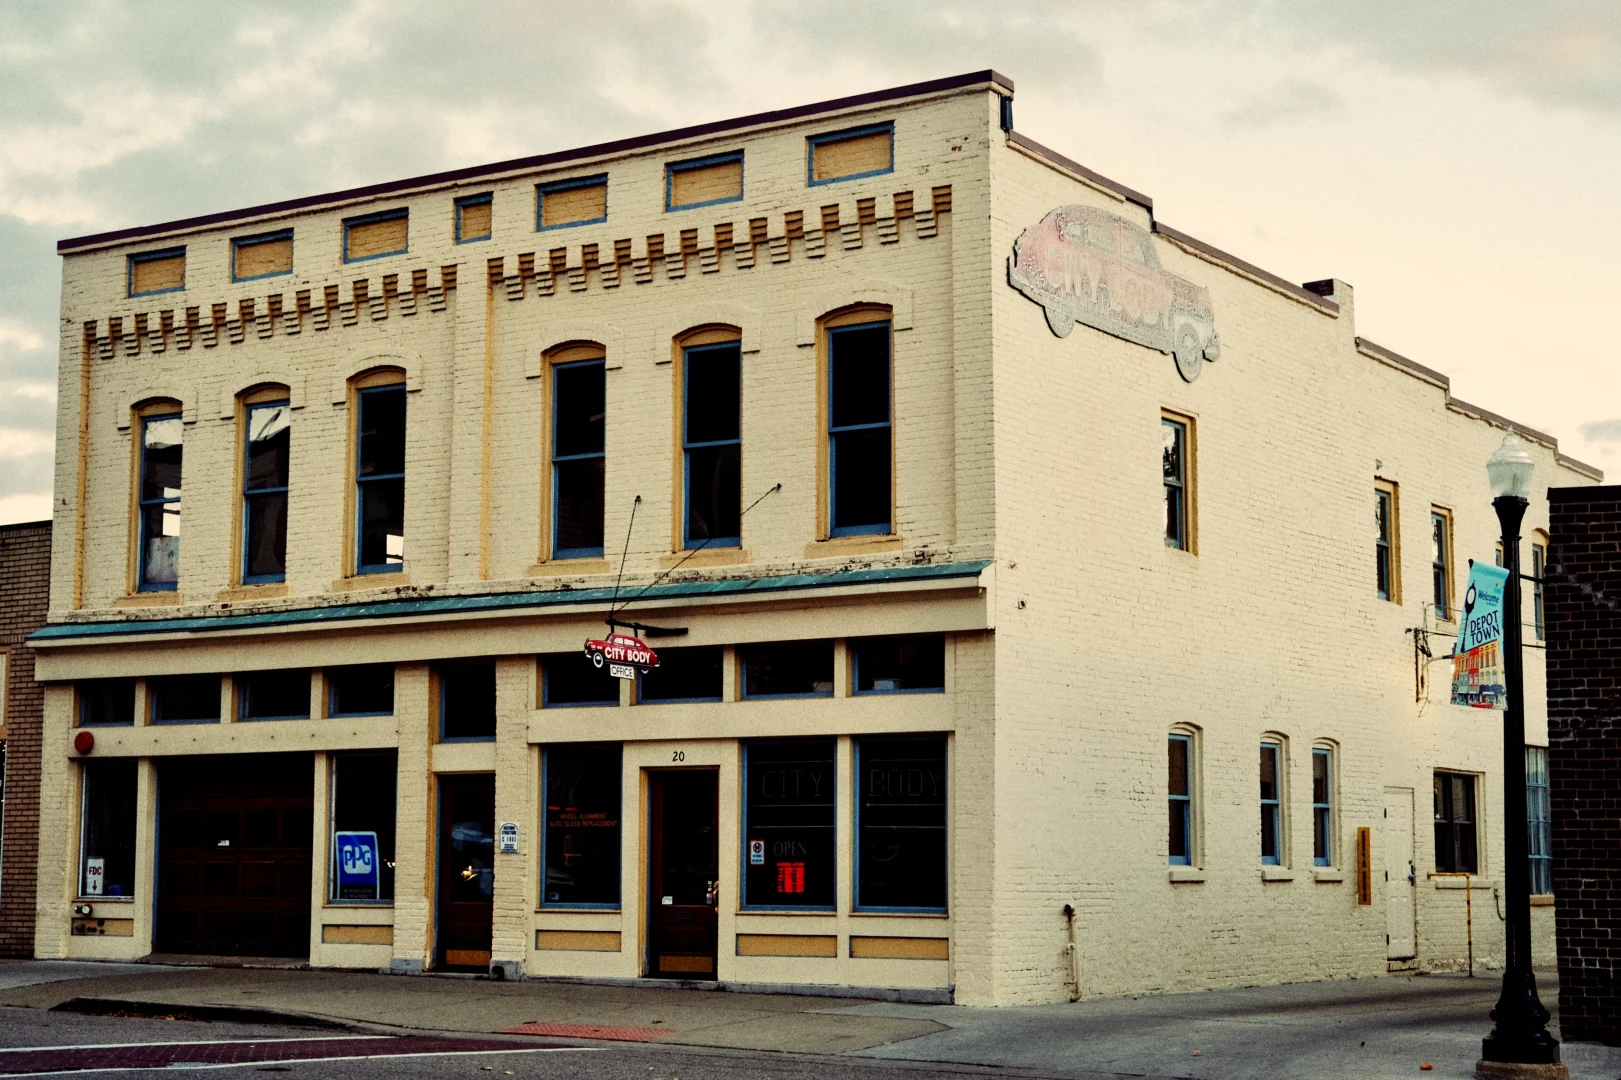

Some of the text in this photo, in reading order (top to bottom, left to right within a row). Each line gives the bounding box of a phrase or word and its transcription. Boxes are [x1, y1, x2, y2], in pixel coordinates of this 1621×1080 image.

[1478, 590, 1499, 604] Welcome
[1470, 610, 1498, 633] DEPOT
[1470, 624, 1500, 646] TOWN
[604, 646, 651, 664] CITY BODY
[611, 666, 633, 678] OFFICE
[672, 751, 685, 762] 20
[762, 769, 823, 798] CITY
[869, 767, 942, 798] BODY
[560, 812, 607, 820] WHEEL ALIGNMENT
[344, 845, 371, 869] PPG
[773, 841, 807, 857] OPEN
[89, 866, 102, 875] FDC
